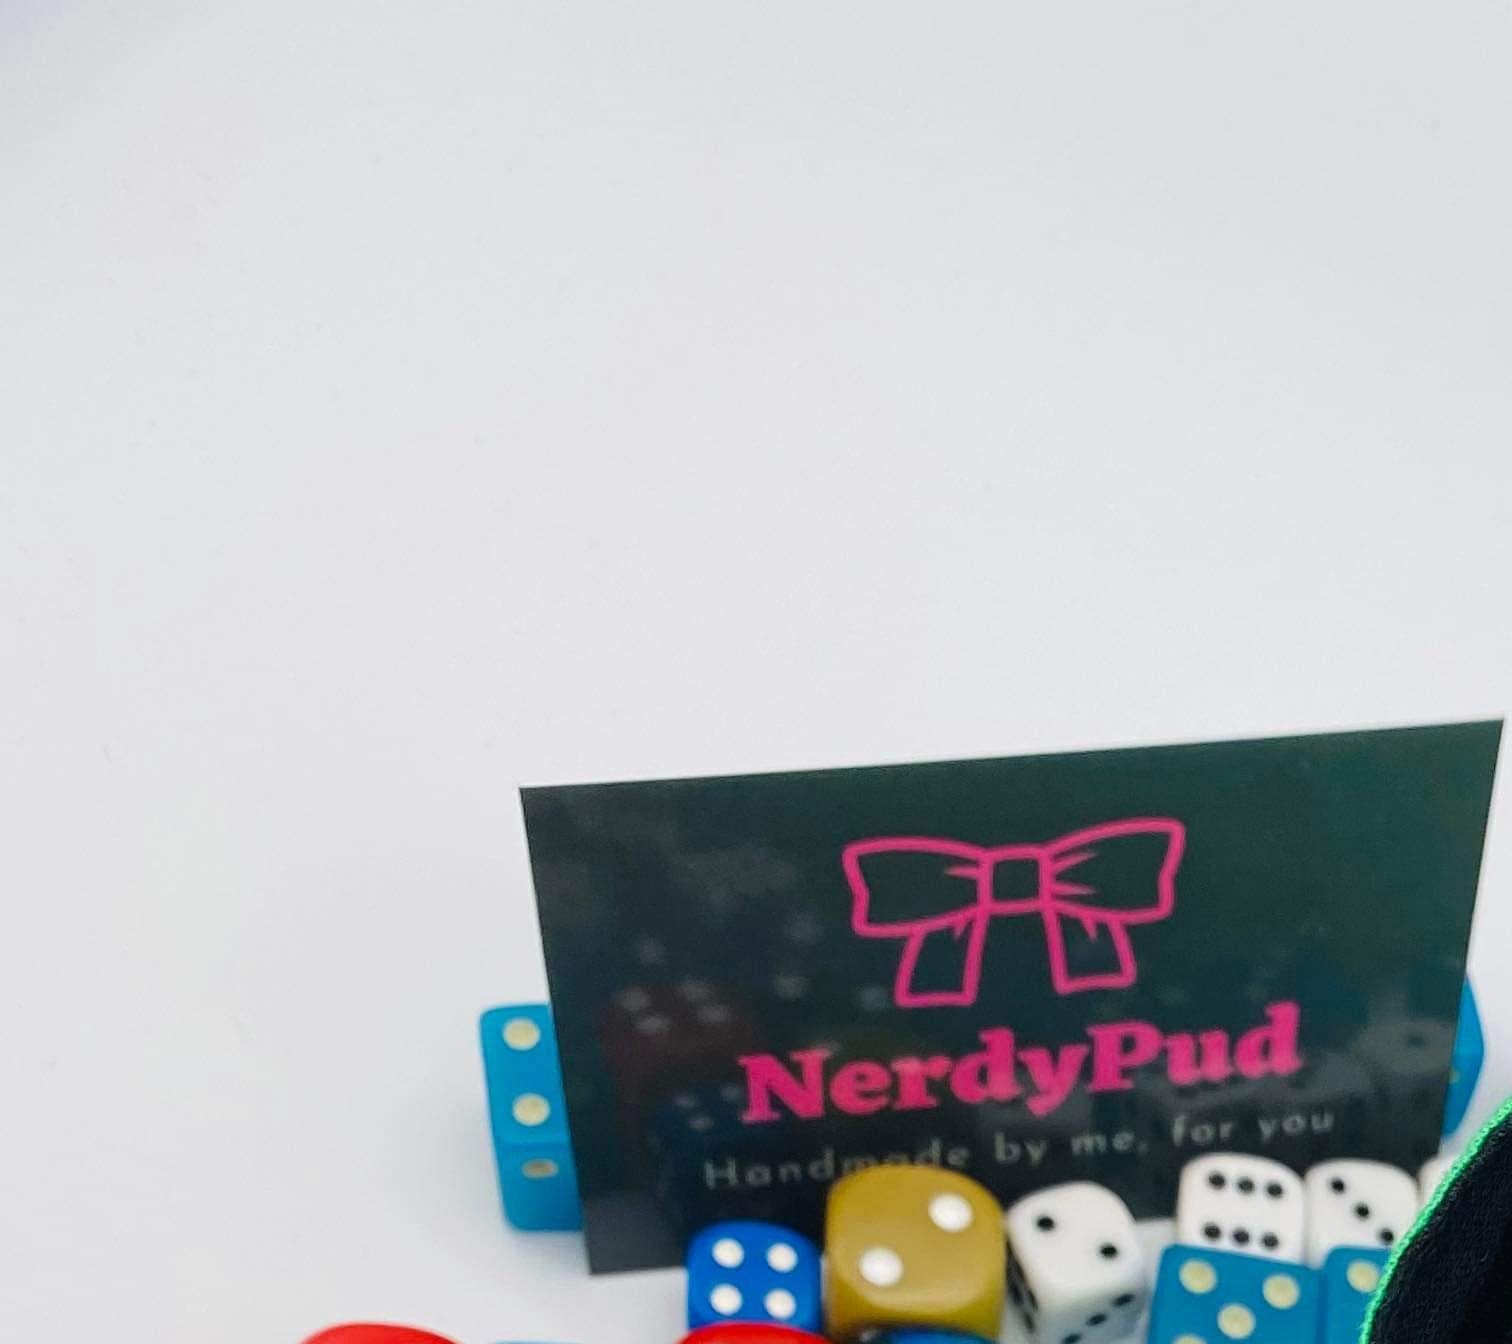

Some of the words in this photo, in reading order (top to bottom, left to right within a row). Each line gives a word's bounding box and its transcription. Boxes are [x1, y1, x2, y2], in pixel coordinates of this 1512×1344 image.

[737, 1001, 1302, 1123] NerdyPud
[995, 1130, 1047, 1168] by
[1172, 1113, 1234, 1147] for
[1258, 1109, 1335, 1143] you
